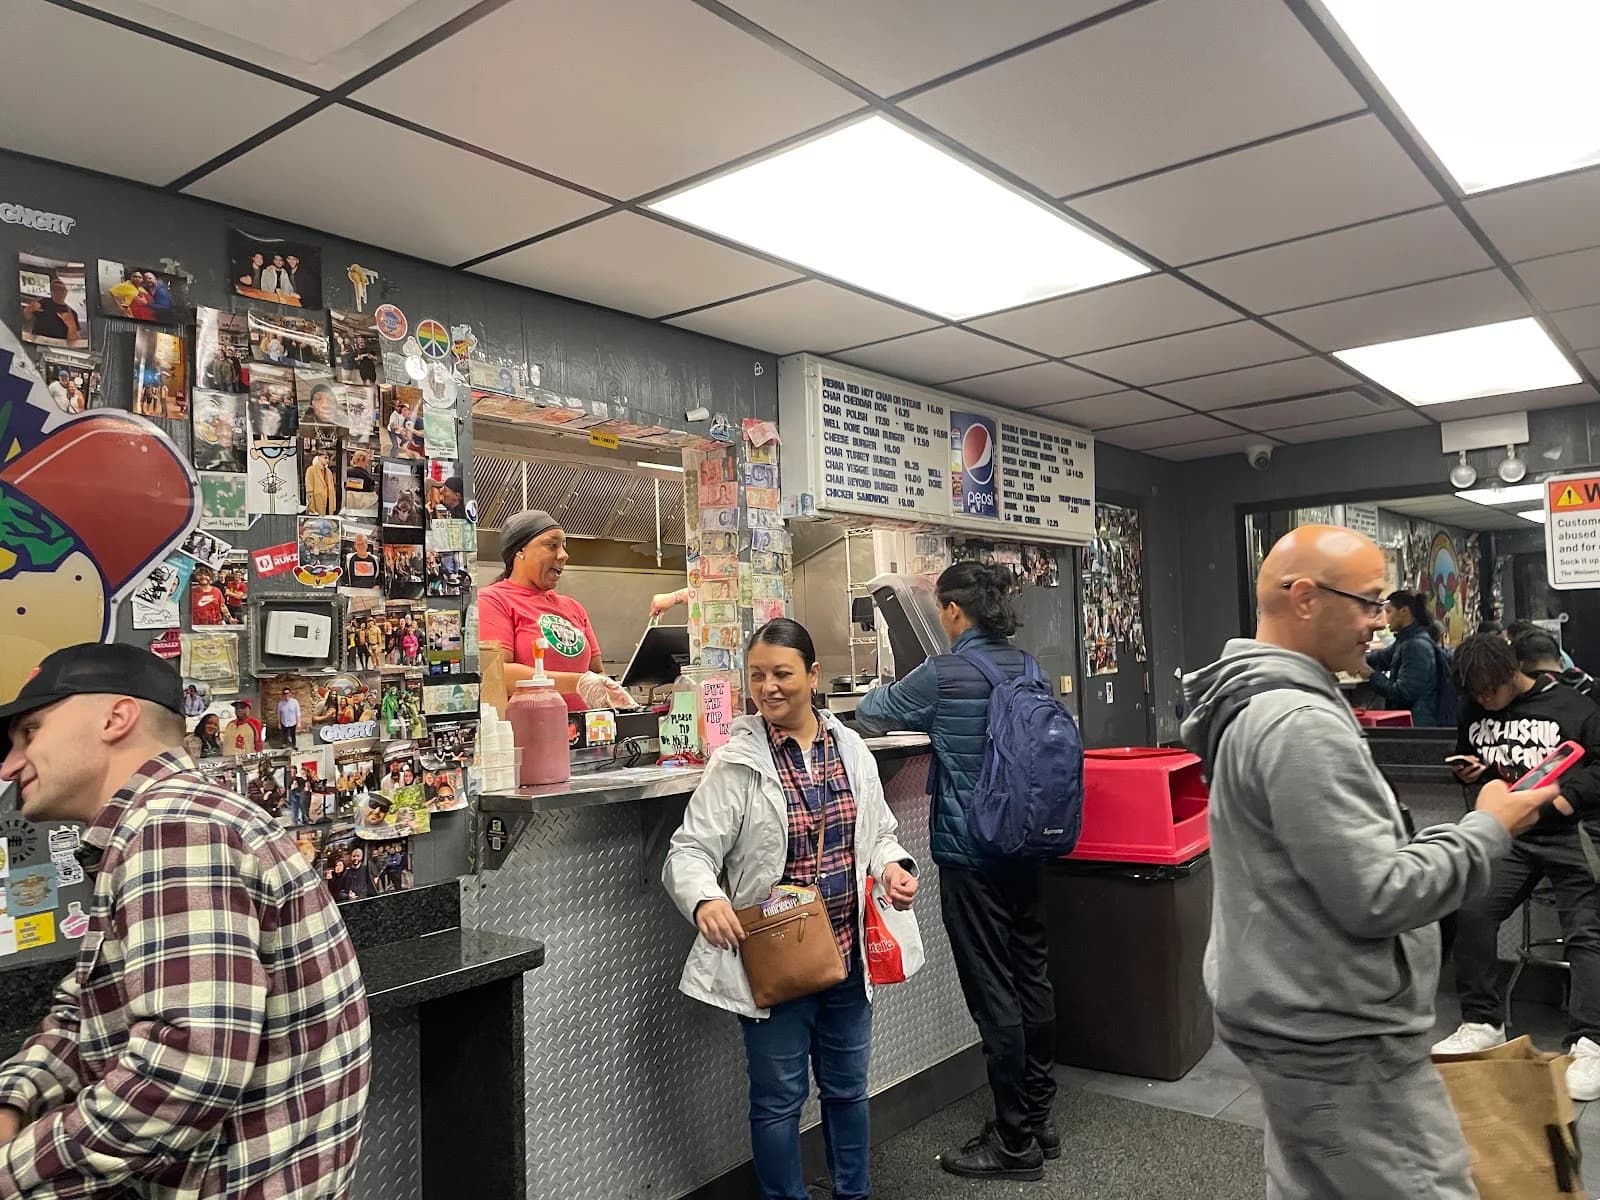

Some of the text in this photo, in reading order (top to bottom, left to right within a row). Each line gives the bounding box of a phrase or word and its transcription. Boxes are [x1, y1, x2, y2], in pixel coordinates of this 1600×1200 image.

[822, 389, 840, 401] CHAR
[843, 394, 872, 409] CHEDDAR
[874, 402, 887, 413] DOG
[847, 383, 859, 394] RED
[861, 387, 873, 398] HOT
[876, 391, 892, 403] CHAR
[893, 395, 902, 404] OR
[823, 403, 841, 416] CHAR
[846, 409, 867, 422] POLISH
[903, 421, 915, 432] VEG
[916, 424, 929, 435] DOG
[823, 417, 840, 429] WELL
[843, 422, 860, 433] DONE
[863, 426, 880, 437] CHAR
[882, 430, 905, 443] BURGER
[823, 432, 849, 445] CHEESE
[852, 437, 876, 450] BURGER
[824, 445, 842, 457] CHAR
[846, 449, 870, 462] TURKEY
[872, 455, 897, 467] BURGER
[825, 459, 844, 471] CHAR
[846, 463, 870, 475] VEGGIE
[872, 467, 896, 480] BURGER
[928, 468, 942, 478] WELL
[825, 473, 844, 485] CHAR
[847, 477, 872, 488] BEYOND
[874, 481, 898, 493] BURGER
[825, 487, 854, 500] CHICKEN
[856, 492, 889, 505] SANDWICH
[967, 491, 993, 506] pepsi
[1003, 490, 1023, 500] BOTTLED
[1558, 529, 1597, 541] abused
[1559, 542, 1596, 553] and for
[556, 643, 579, 654] CITY
[704, 683, 725, 695] PUT
[705, 711, 722, 723] TIP
